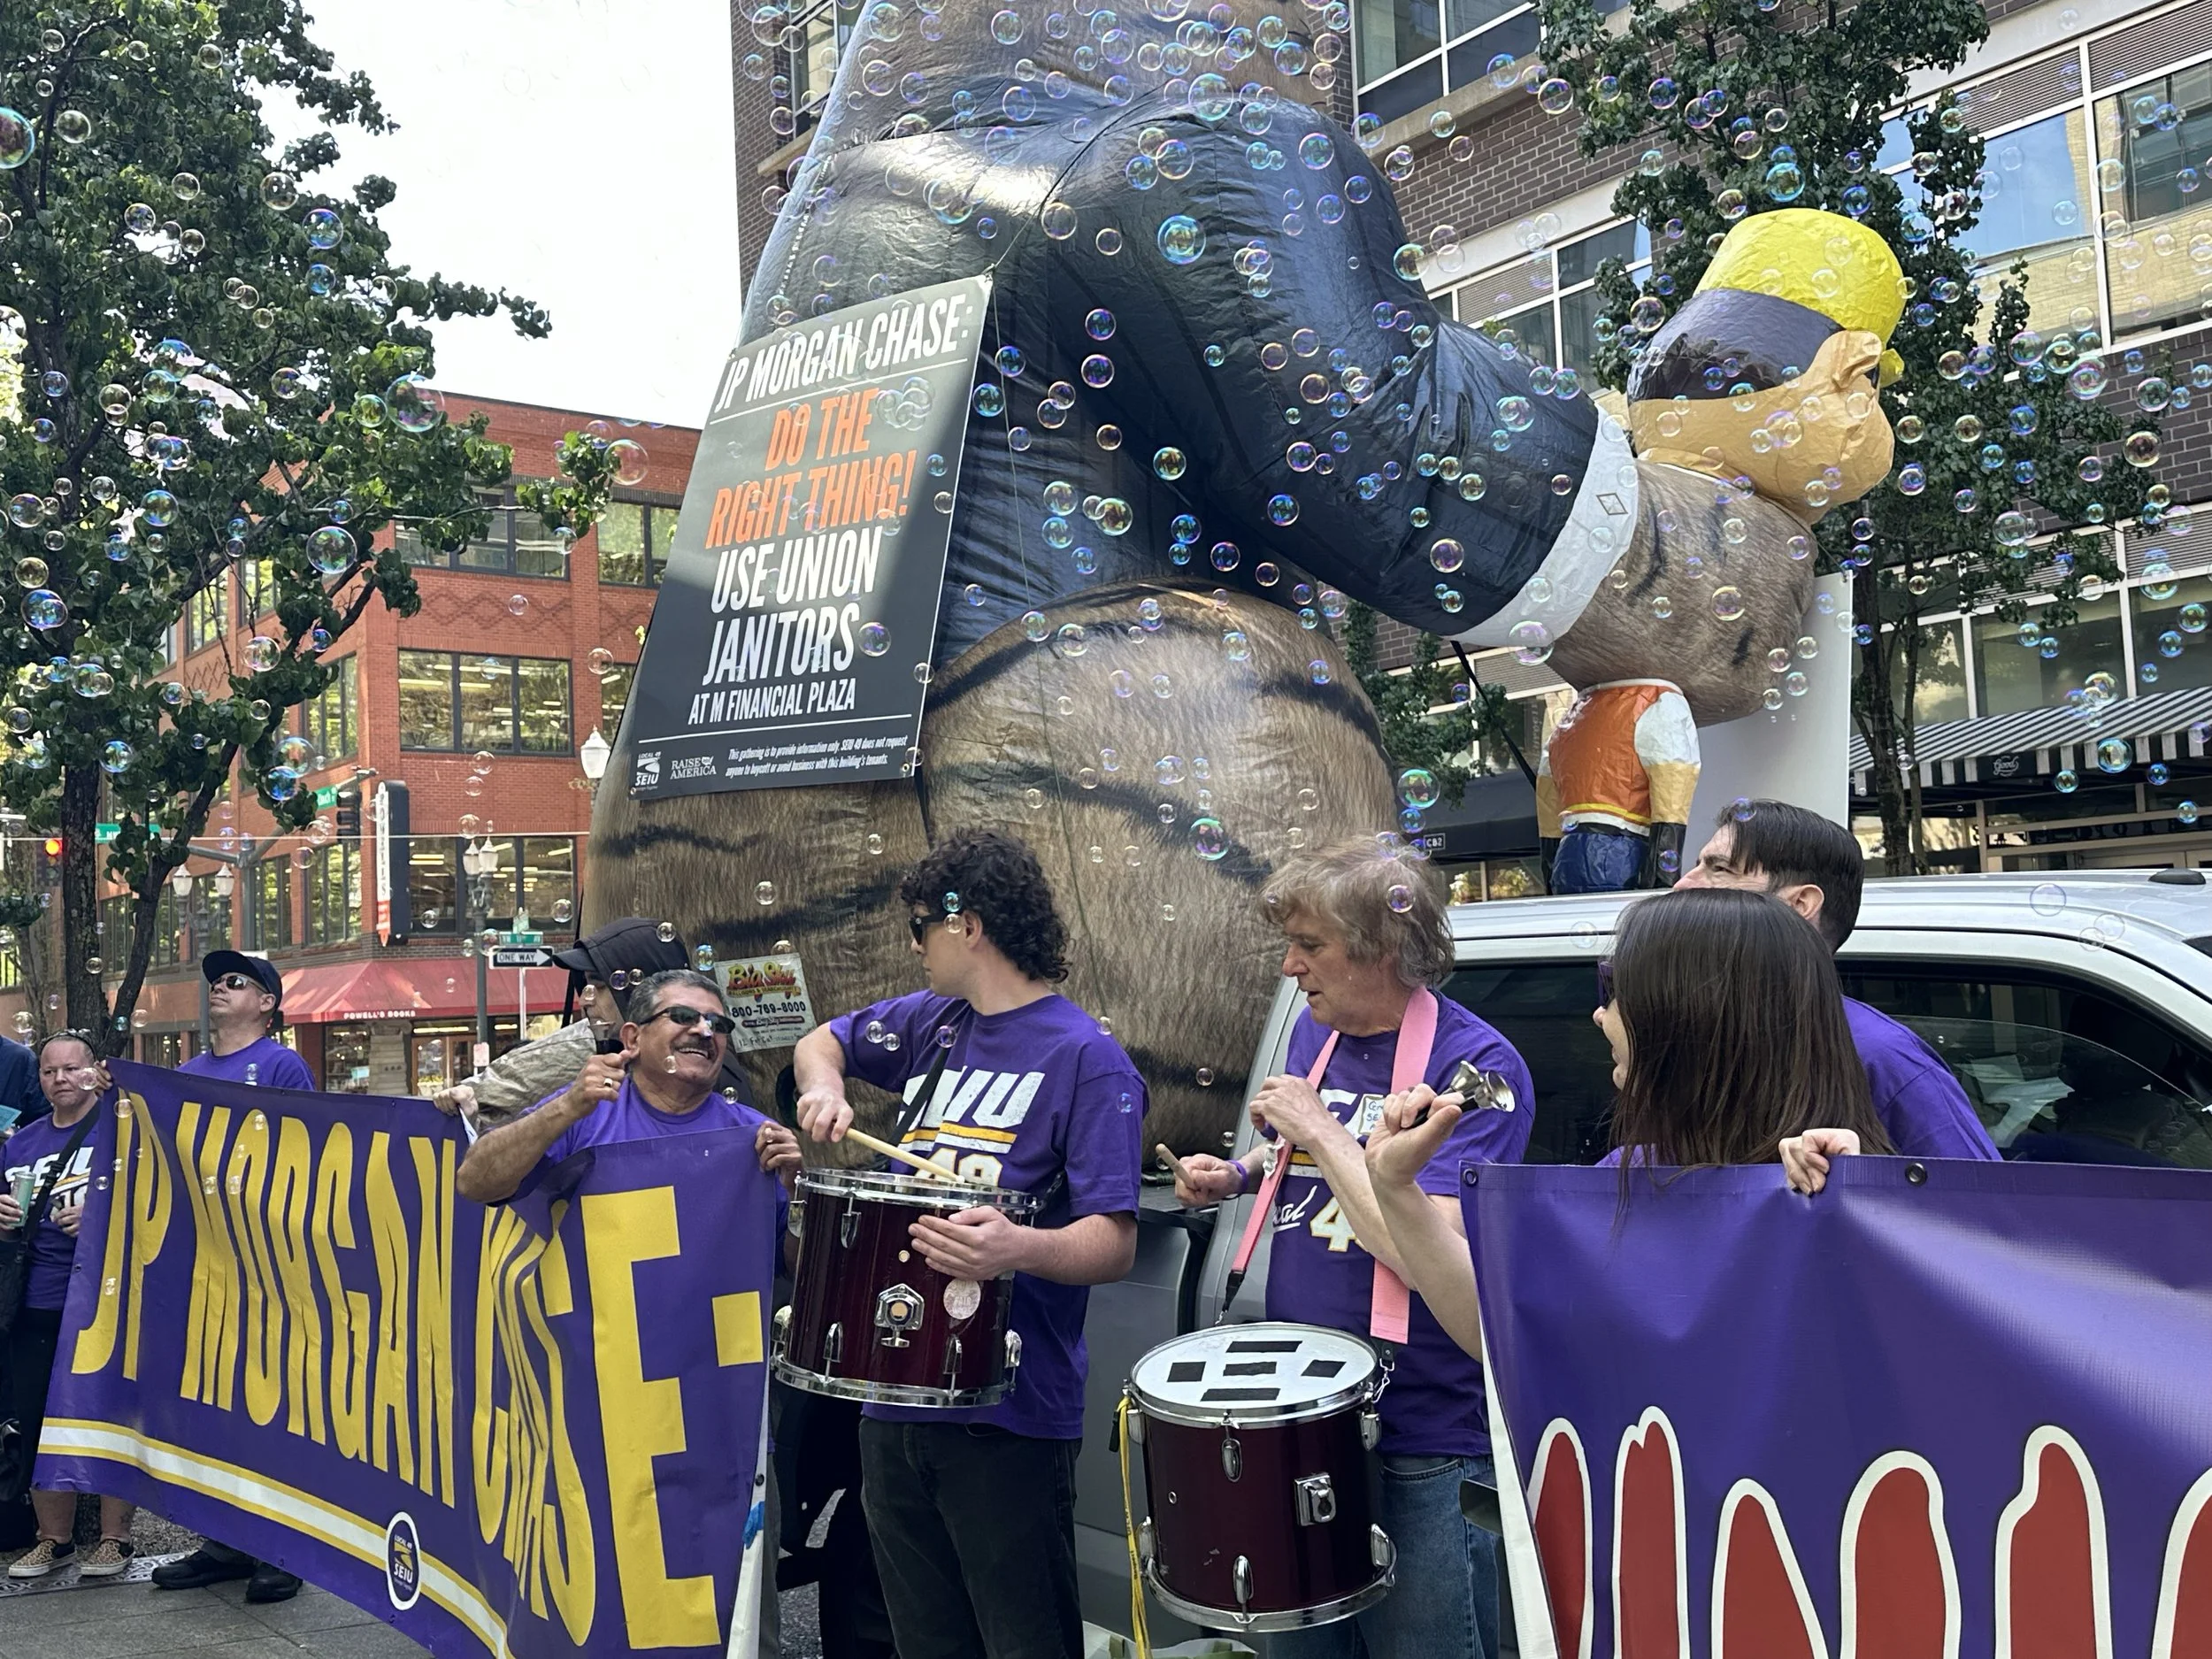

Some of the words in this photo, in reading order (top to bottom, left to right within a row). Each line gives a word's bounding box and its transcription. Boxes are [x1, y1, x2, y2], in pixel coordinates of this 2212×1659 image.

[714, 357, 750, 413] JP
[745, 318, 864, 403] MORGAN
[864, 293, 974, 370] CHASE:
[764, 403, 812, 472] DO
[816, 388, 880, 460] THE
[705, 471, 803, 549] RIGHT
[804, 449, 918, 532] THING!
[710, 542, 776, 614] USE
[776, 526, 884, 605] UNION
[702, 602, 860, 687] JANITORS
[687, 692, 710, 726] AT
[710, 691, 726, 723] M
[726, 683, 803, 721] FINANCIAL
[806, 678, 856, 714] PLAZA
[728, 747, 740, 761] This
[738, 746, 764, 762] gathering
[775, 743, 796, 759] provide
[796, 741, 827, 755] information
[826, 740, 841, 755] only.
[841, 738, 854, 751] SEIU
[861, 737, 875, 749] does
[875, 737, 886, 749] not
[885, 735, 908, 751] request
[670, 764, 718, 780] AMERICA
[672, 757, 702, 771] RAISE
[725, 766, 745, 780] anyone
[749, 761, 772, 777] boycott
[776, 760, 793, 772] avoid
[792, 759, 815, 772] business
[815, 757, 828, 770] with
[827, 756, 840, 769] this
[839, 754, 866, 769] building's
[865, 753, 888, 766] tenants.
[634, 773, 659, 787] SEIU
[1426, 837, 1443, 848] CB2
[499, 953, 516, 962] ONE
[518, 953, 535, 962] WAY
[343, 1010, 386, 1019] POWELL'S
[388, 1010, 416, 1018] BOOKS
[72, 1087, 173, 1380] JP
[176, 1101, 457, 1509] MORGAN
[393, 1563, 413, 1584] SEIU
